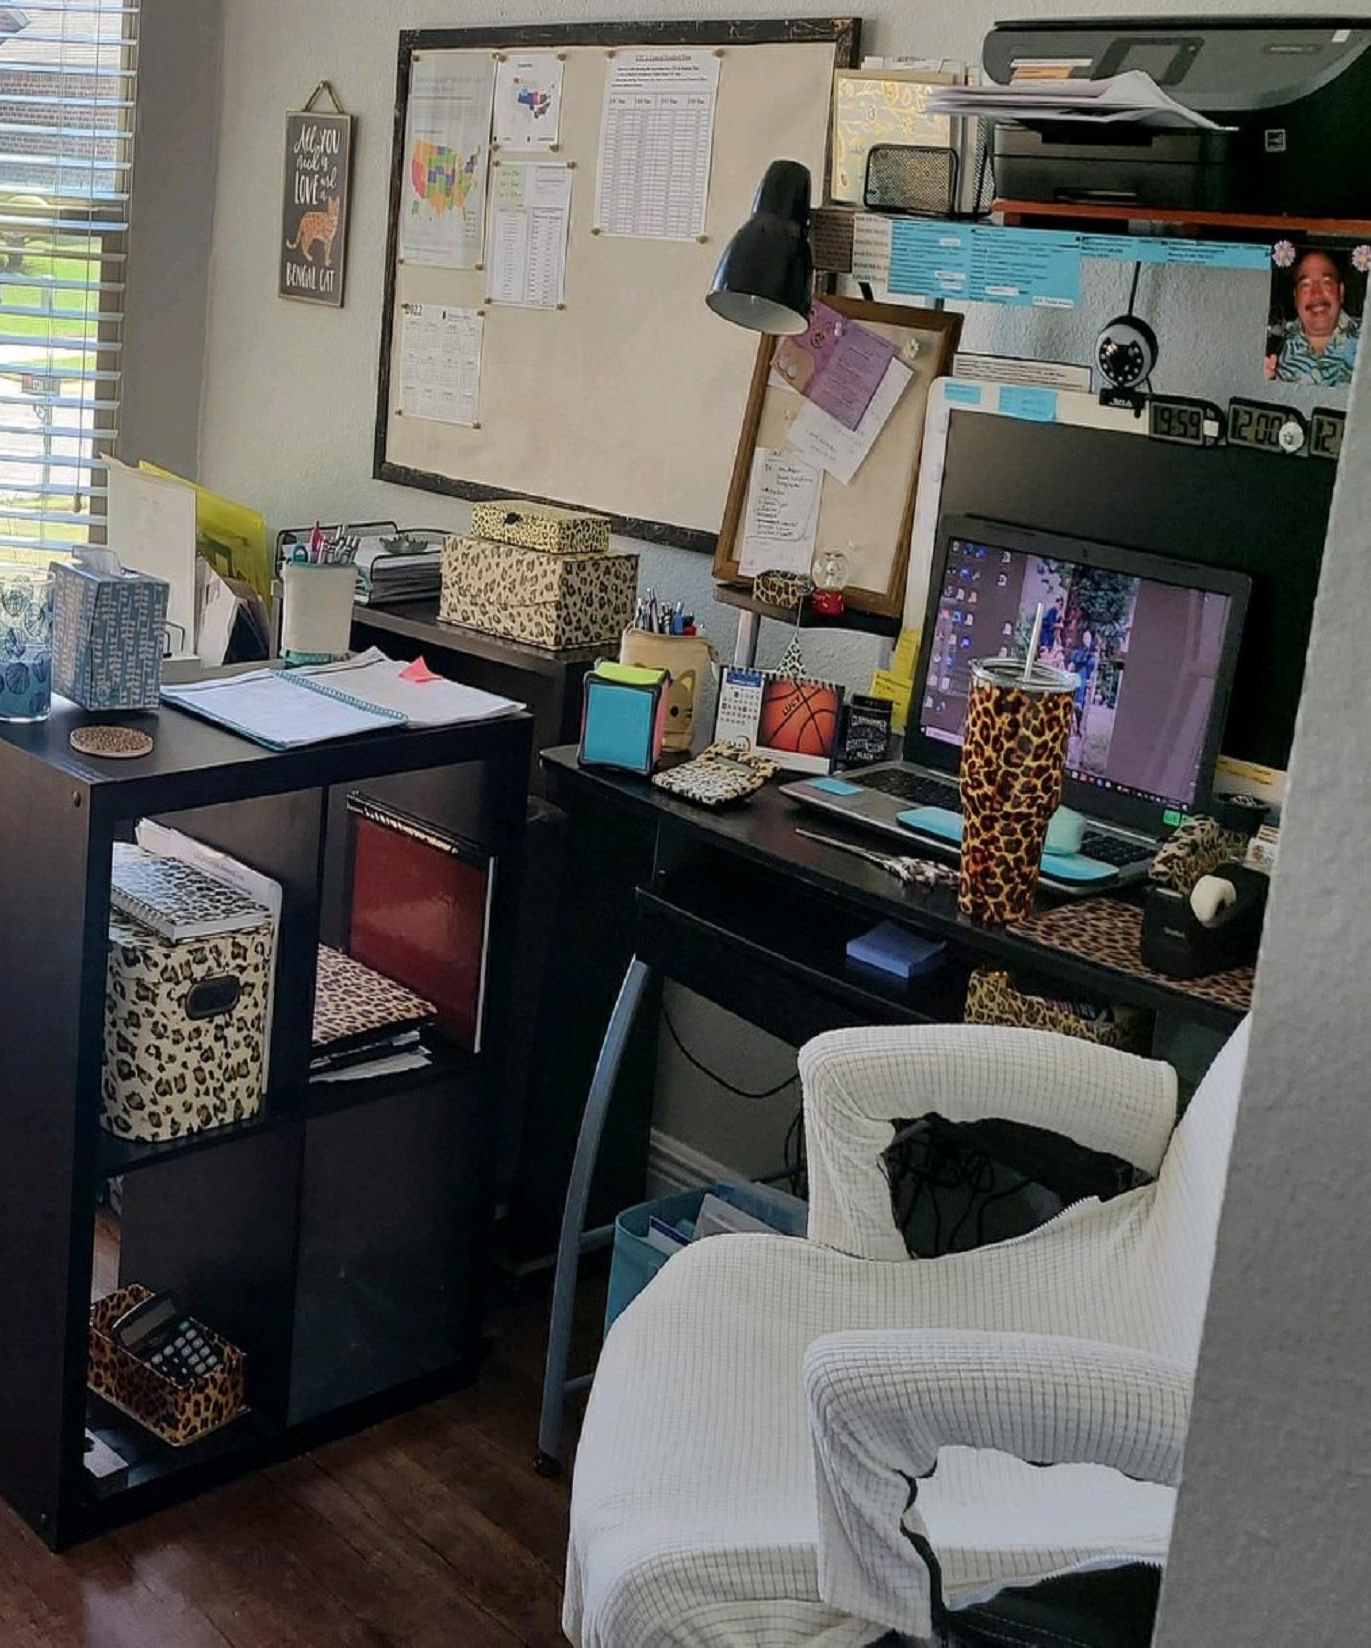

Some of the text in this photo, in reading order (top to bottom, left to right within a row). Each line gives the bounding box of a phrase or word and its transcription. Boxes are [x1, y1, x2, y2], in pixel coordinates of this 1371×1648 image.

[320, 128, 340, 154] YOU
[295, 170, 319, 205] LOVE
[286, 261, 335, 293] BENGAL CAT
[782, 694, 801, 717] LUCY
